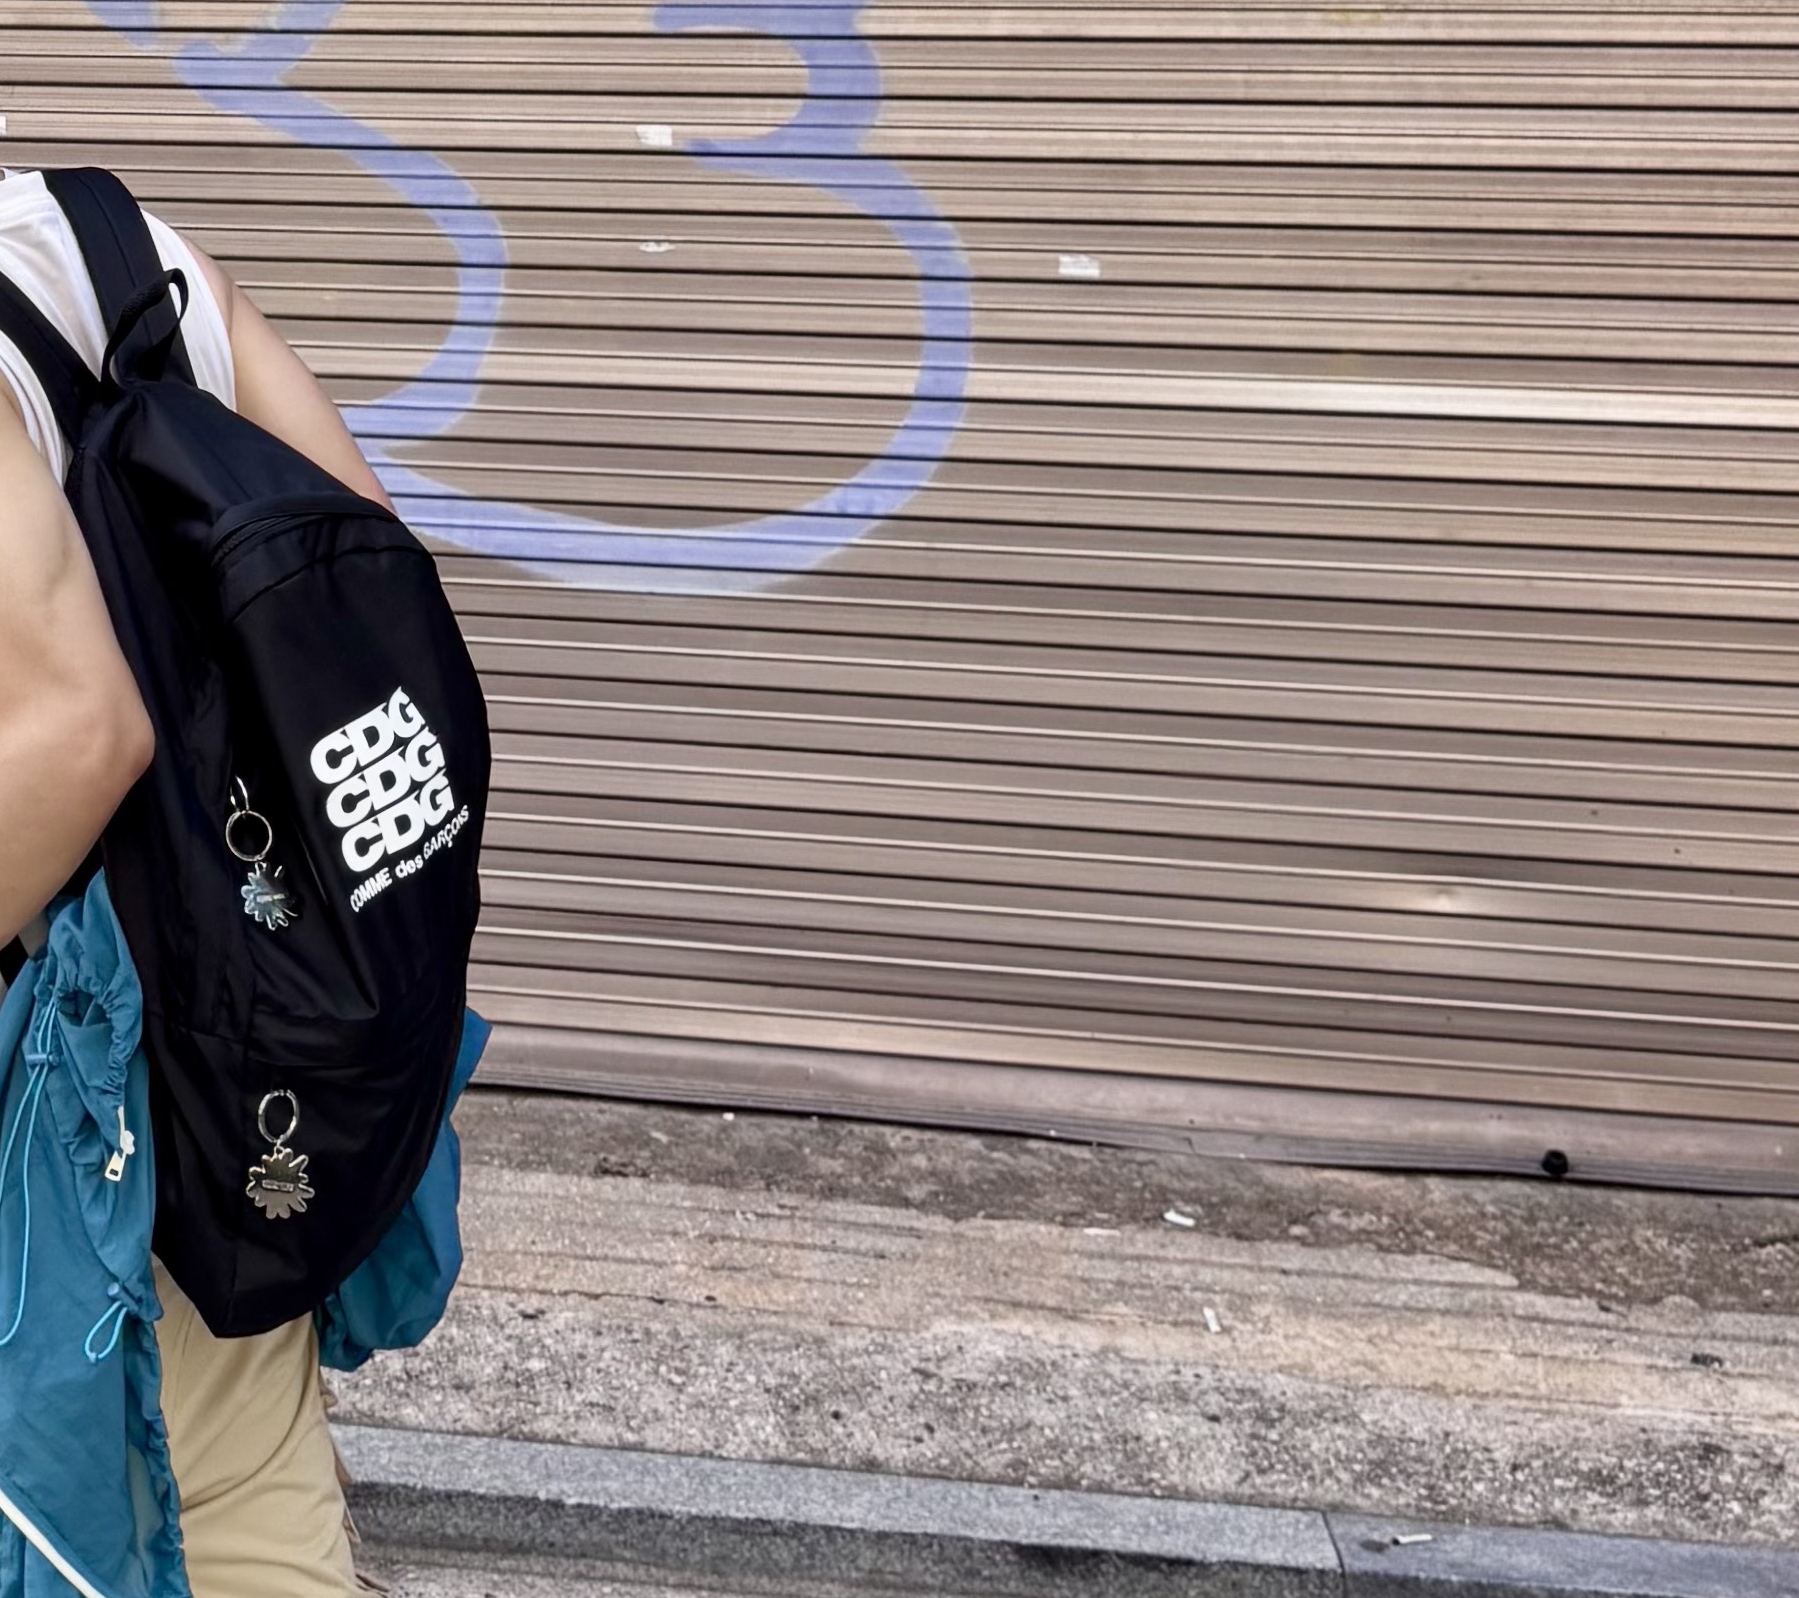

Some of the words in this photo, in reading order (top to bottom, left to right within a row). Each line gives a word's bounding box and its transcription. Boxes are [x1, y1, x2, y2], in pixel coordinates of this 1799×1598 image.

[309, 685, 427, 785] CDG
[324, 725, 447, 828] CDG
[340, 767, 455, 872] CDG
[349, 866, 394, 914] COMME
